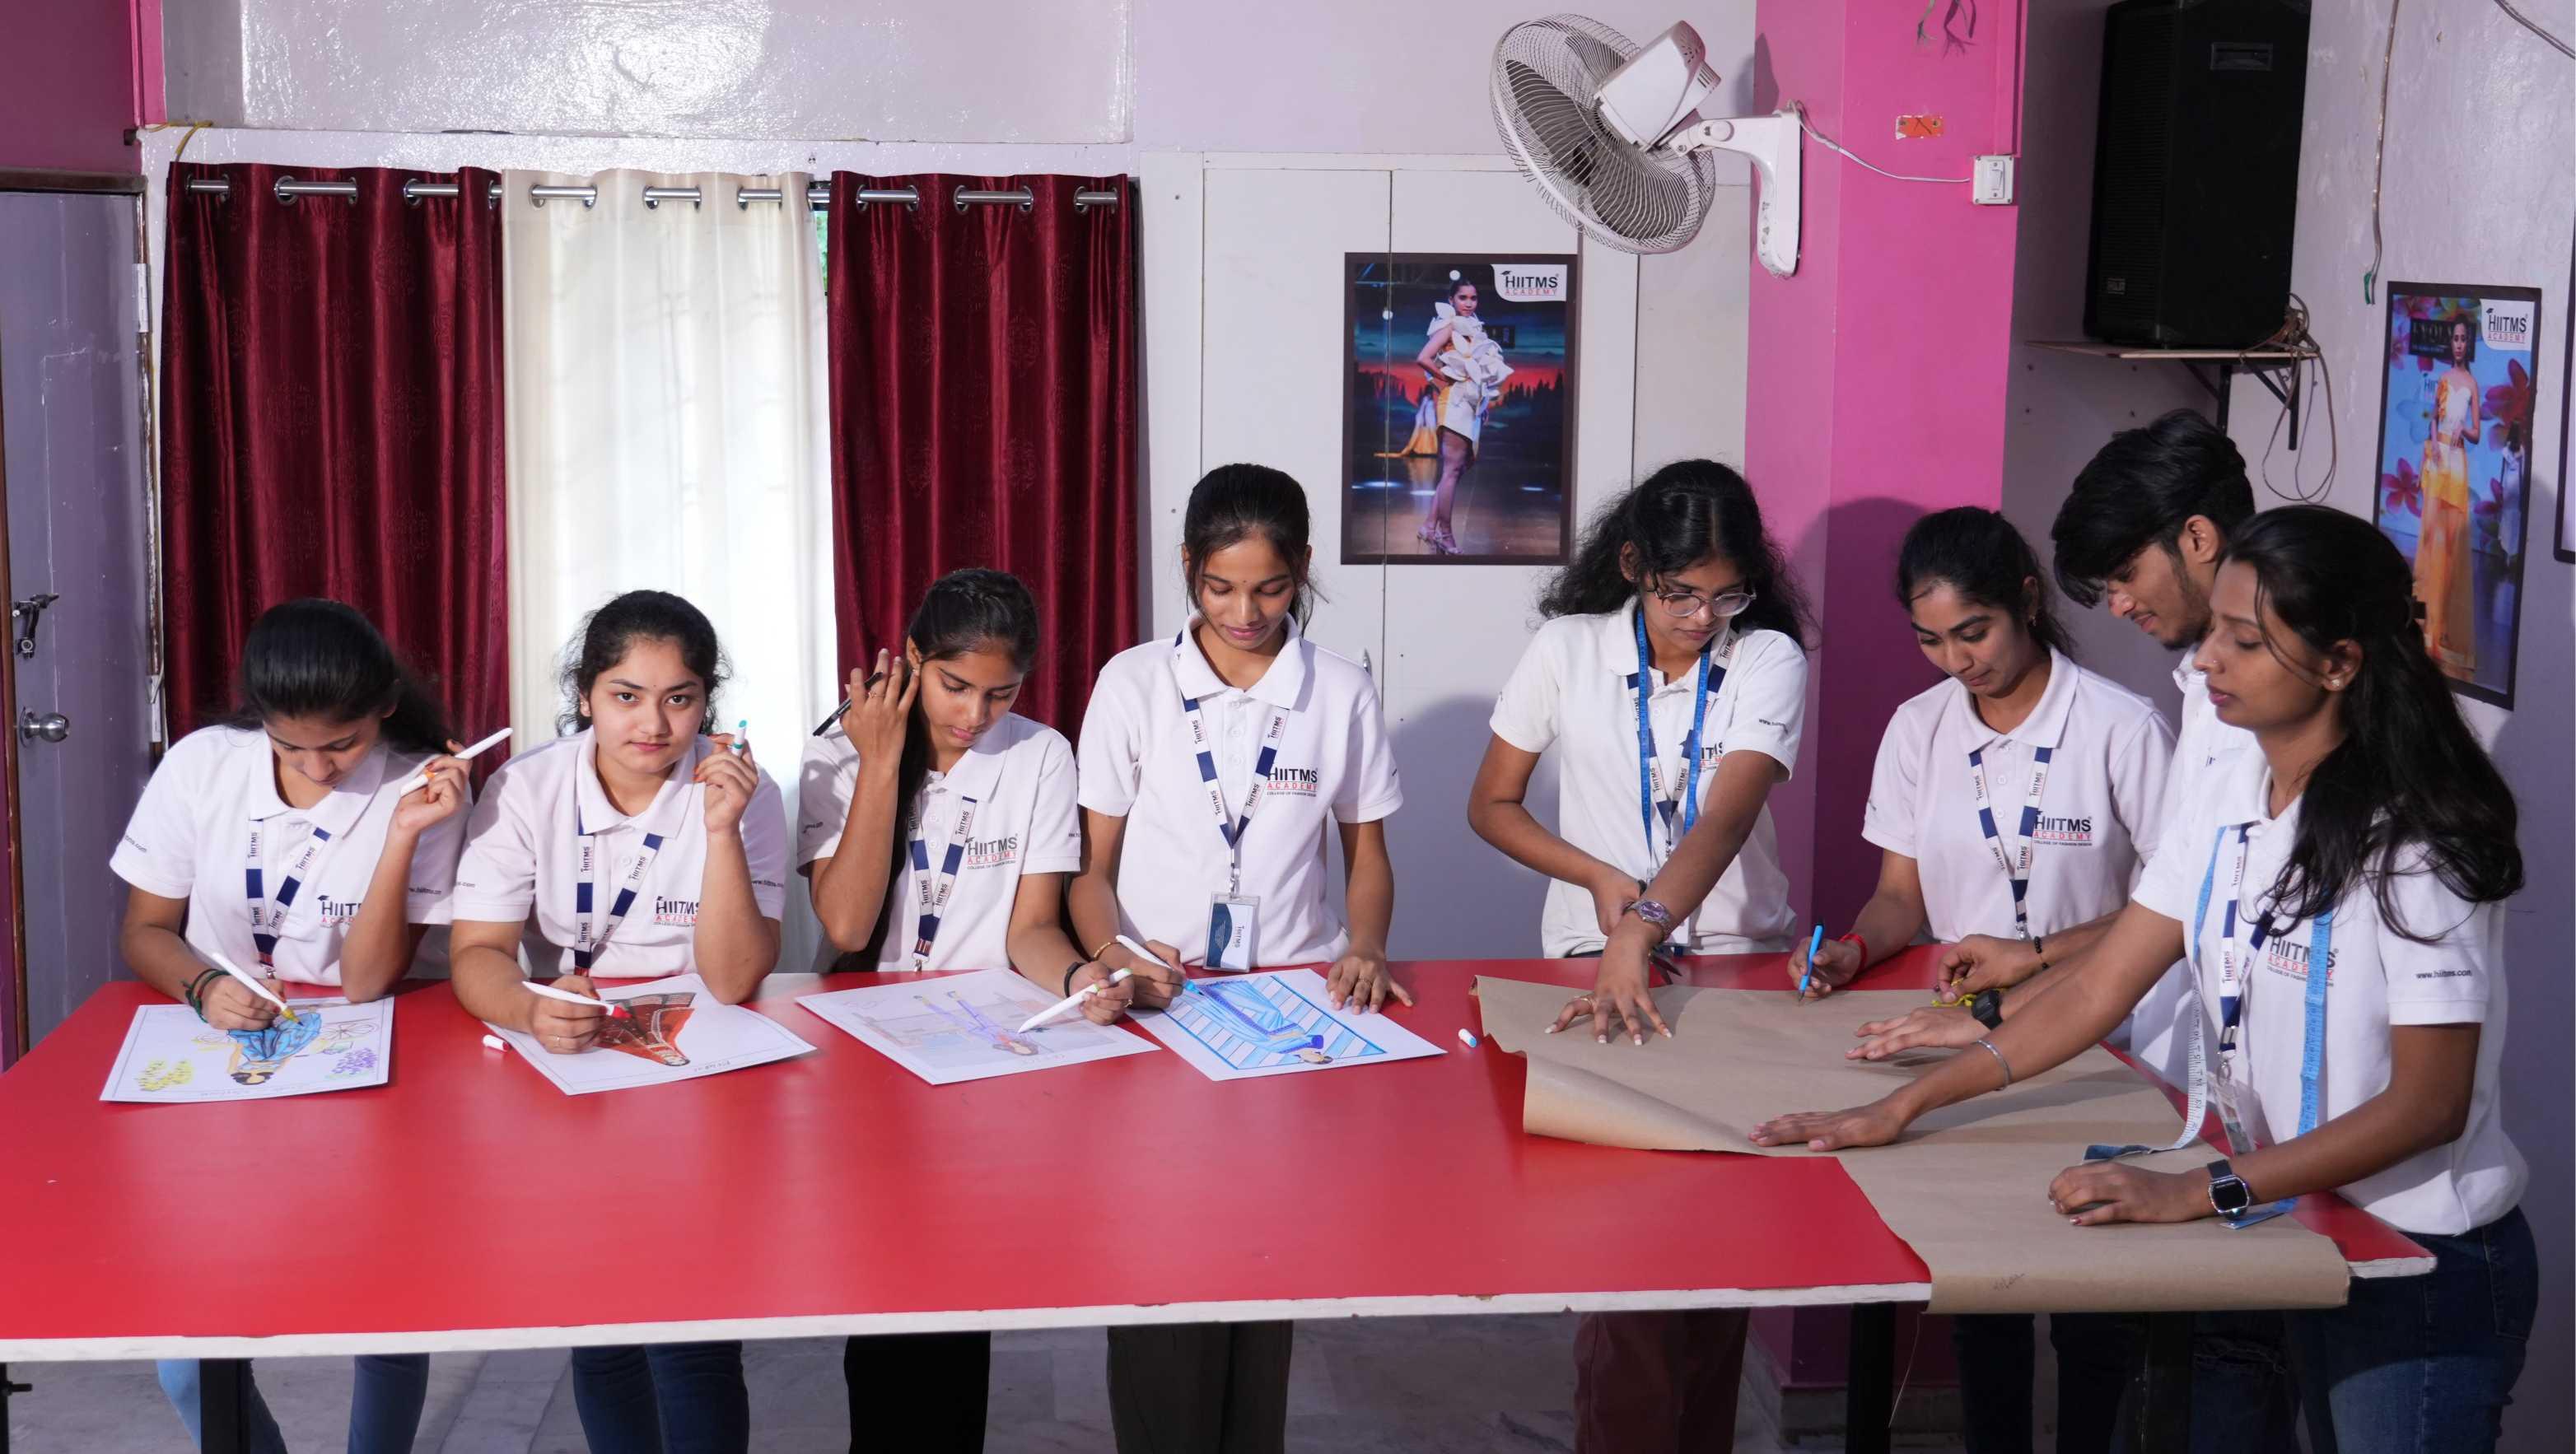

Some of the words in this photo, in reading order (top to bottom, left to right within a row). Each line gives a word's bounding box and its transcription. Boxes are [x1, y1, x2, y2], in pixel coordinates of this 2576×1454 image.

[1505, 276, 1558, 288] HIITMS
[2488, 315, 2527, 333] HIITMS
[2488, 333, 2526, 343] ACADEMY
[1267, 767, 1318, 783] HIITMS
[958, 810, 969, 835] HIITMS
[2035, 816, 2091, 832] HIITMS
[2034, 832, 2091, 840] ACADEMY
[968, 837, 1017, 855] HIITMS
[968, 851, 1015, 864] ACADEMY
[322, 901, 362, 916] HIIT
